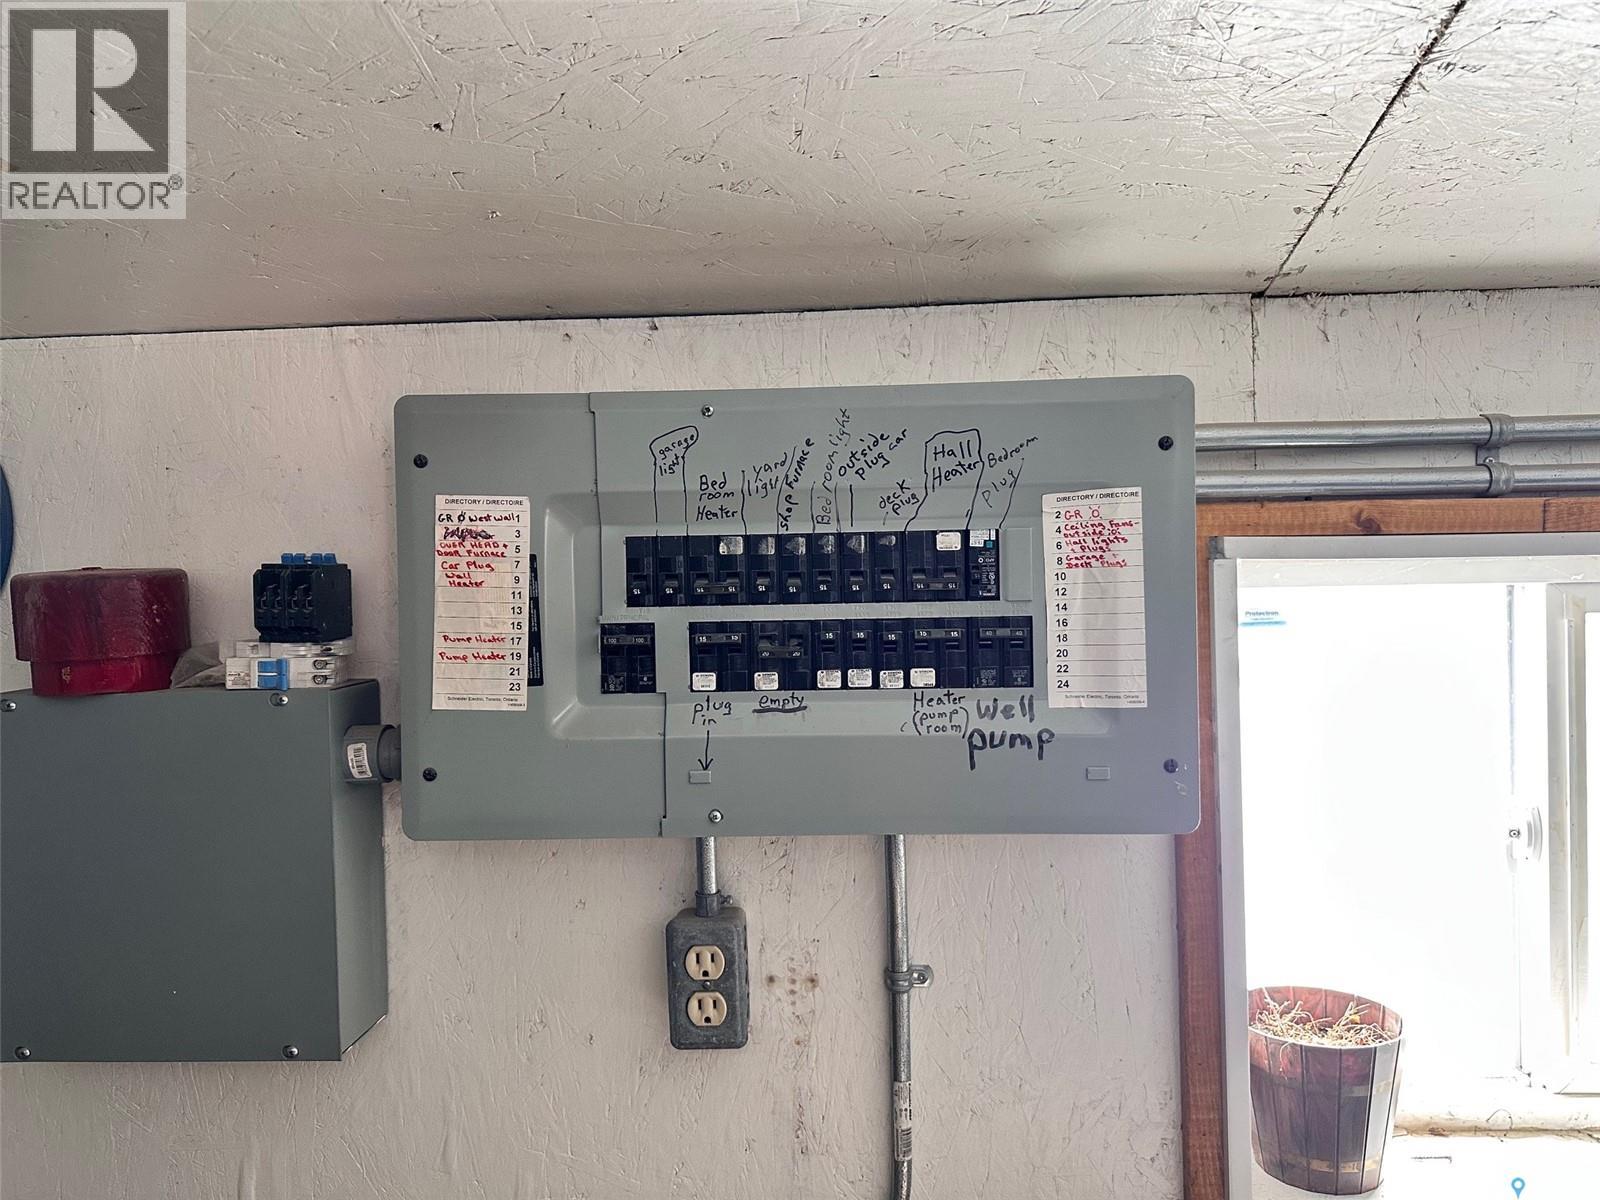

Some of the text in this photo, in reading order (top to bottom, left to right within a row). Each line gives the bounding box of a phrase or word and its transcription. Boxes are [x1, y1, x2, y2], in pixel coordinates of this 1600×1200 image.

[889, 428, 907, 451] car
[658, 434, 695, 460] garage
[933, 440, 972, 461] Hall
[987, 436, 1038, 468] Bedroom
[932, 460, 980, 492] Heater
[700, 471, 727, 491] Bed
[699, 491, 735, 502] room
[879, 479, 910, 509] deck
[1056, 494, 1095, 503] DIRECTORY
[1100, 491, 1139, 499] DIRECTOIRE
[696, 505, 738, 522] Heater
[1055, 511, 1061, 519] 2
[1064, 509, 1083, 520] GR
[515, 514, 520, 523] 1
[515, 530, 521, 538] 3
[1055, 526, 1062, 534] 4
[515, 545, 521, 554] 5
[1057, 557, 1063, 565] 8
[1065, 554, 1106, 562] Garage
[441, 561, 460, 570] Car
[514, 576, 520, 584] 9
[1054, 572, 1066, 581] 10
[448, 580, 485, 588] Heater
[511, 591, 522, 600] 11
[1055, 587, 1067, 596] 12
[511, 606, 523, 615] 13
[1055, 603, 1068, 612] 14
[510, 622, 523, 630] 15
[1056, 618, 1068, 627] 16
[442, 634, 506, 644] Pump Heater
[510, 637, 522, 646] 17
[1056, 634, 1068, 643] 18
[439, 651, 507, 663] Pump Heater
[510, 652, 521, 661] 19
[1056, 649, 1069, 657] 20
[509, 667, 521, 676] 21
[1056, 664, 1069, 673] 22
[509, 683, 521, 691] 23
[1057, 680, 1069, 688] 24
[759, 692, 804, 710] empty
[914, 690, 966, 712] Heater
[701, 714, 717, 726] in
